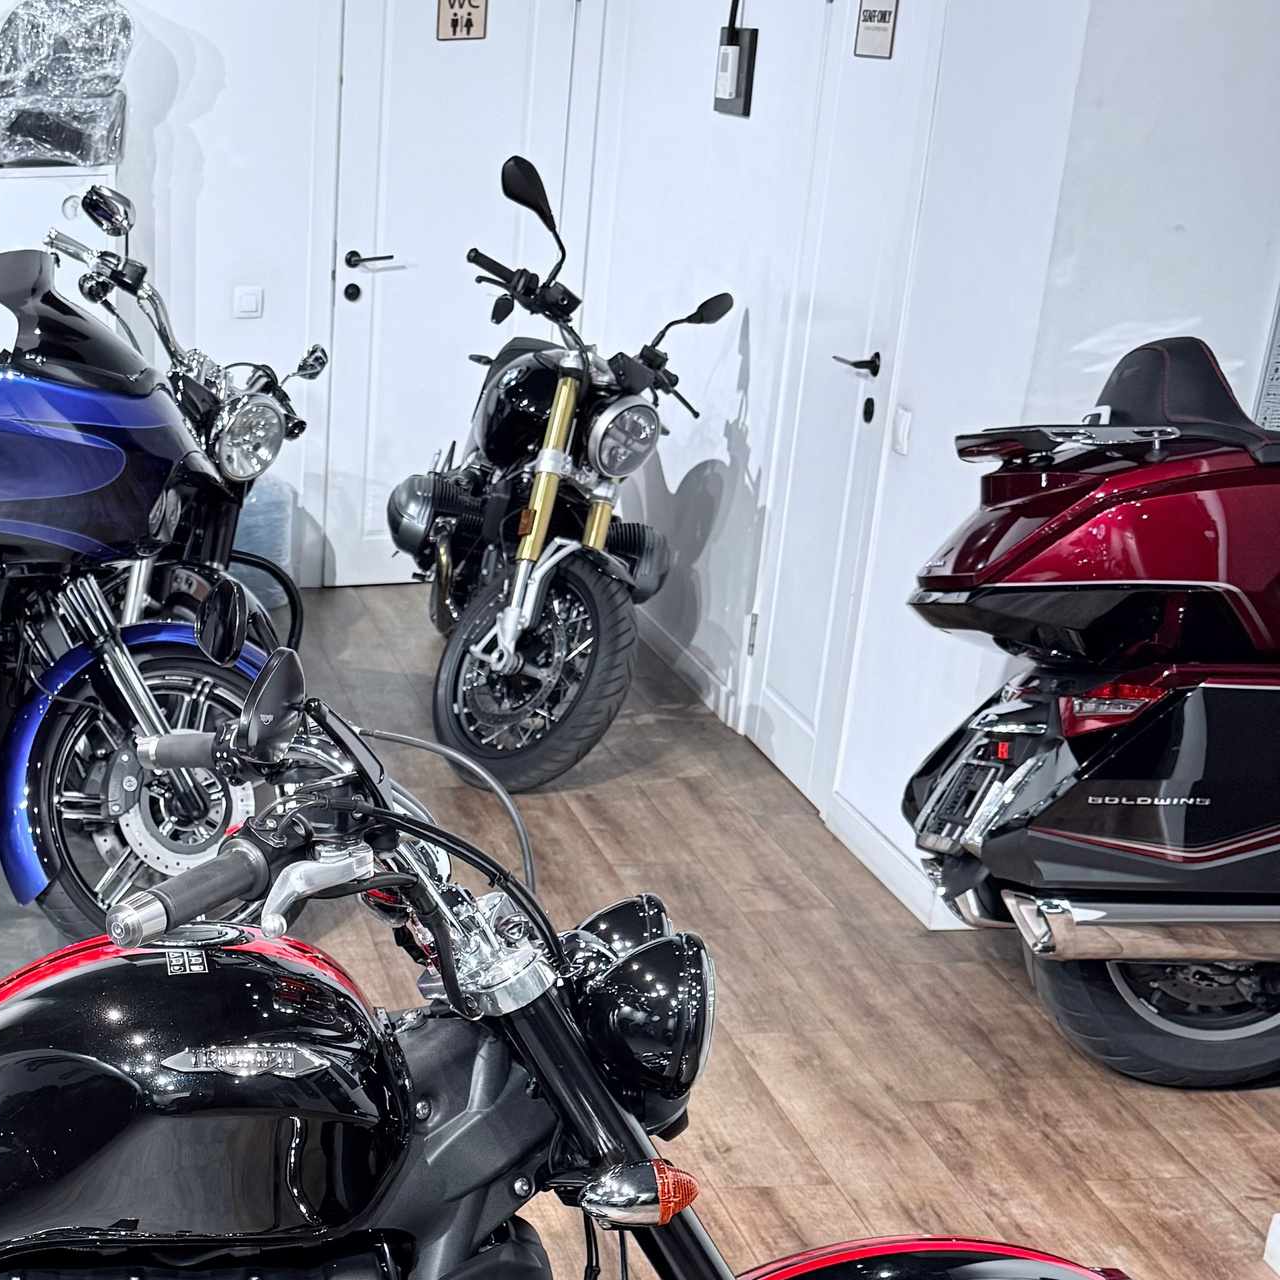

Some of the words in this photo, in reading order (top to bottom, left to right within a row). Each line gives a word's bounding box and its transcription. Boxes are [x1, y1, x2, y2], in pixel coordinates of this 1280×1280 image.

[448, 0, 480, 9] WC
[862, 9, 877, 22] STAFF
[877, 10, 892, 23] ONLY
[1087, 796, 1211, 806] GOLDWING
[191, 1049, 295, 1068] TRIUMPH
